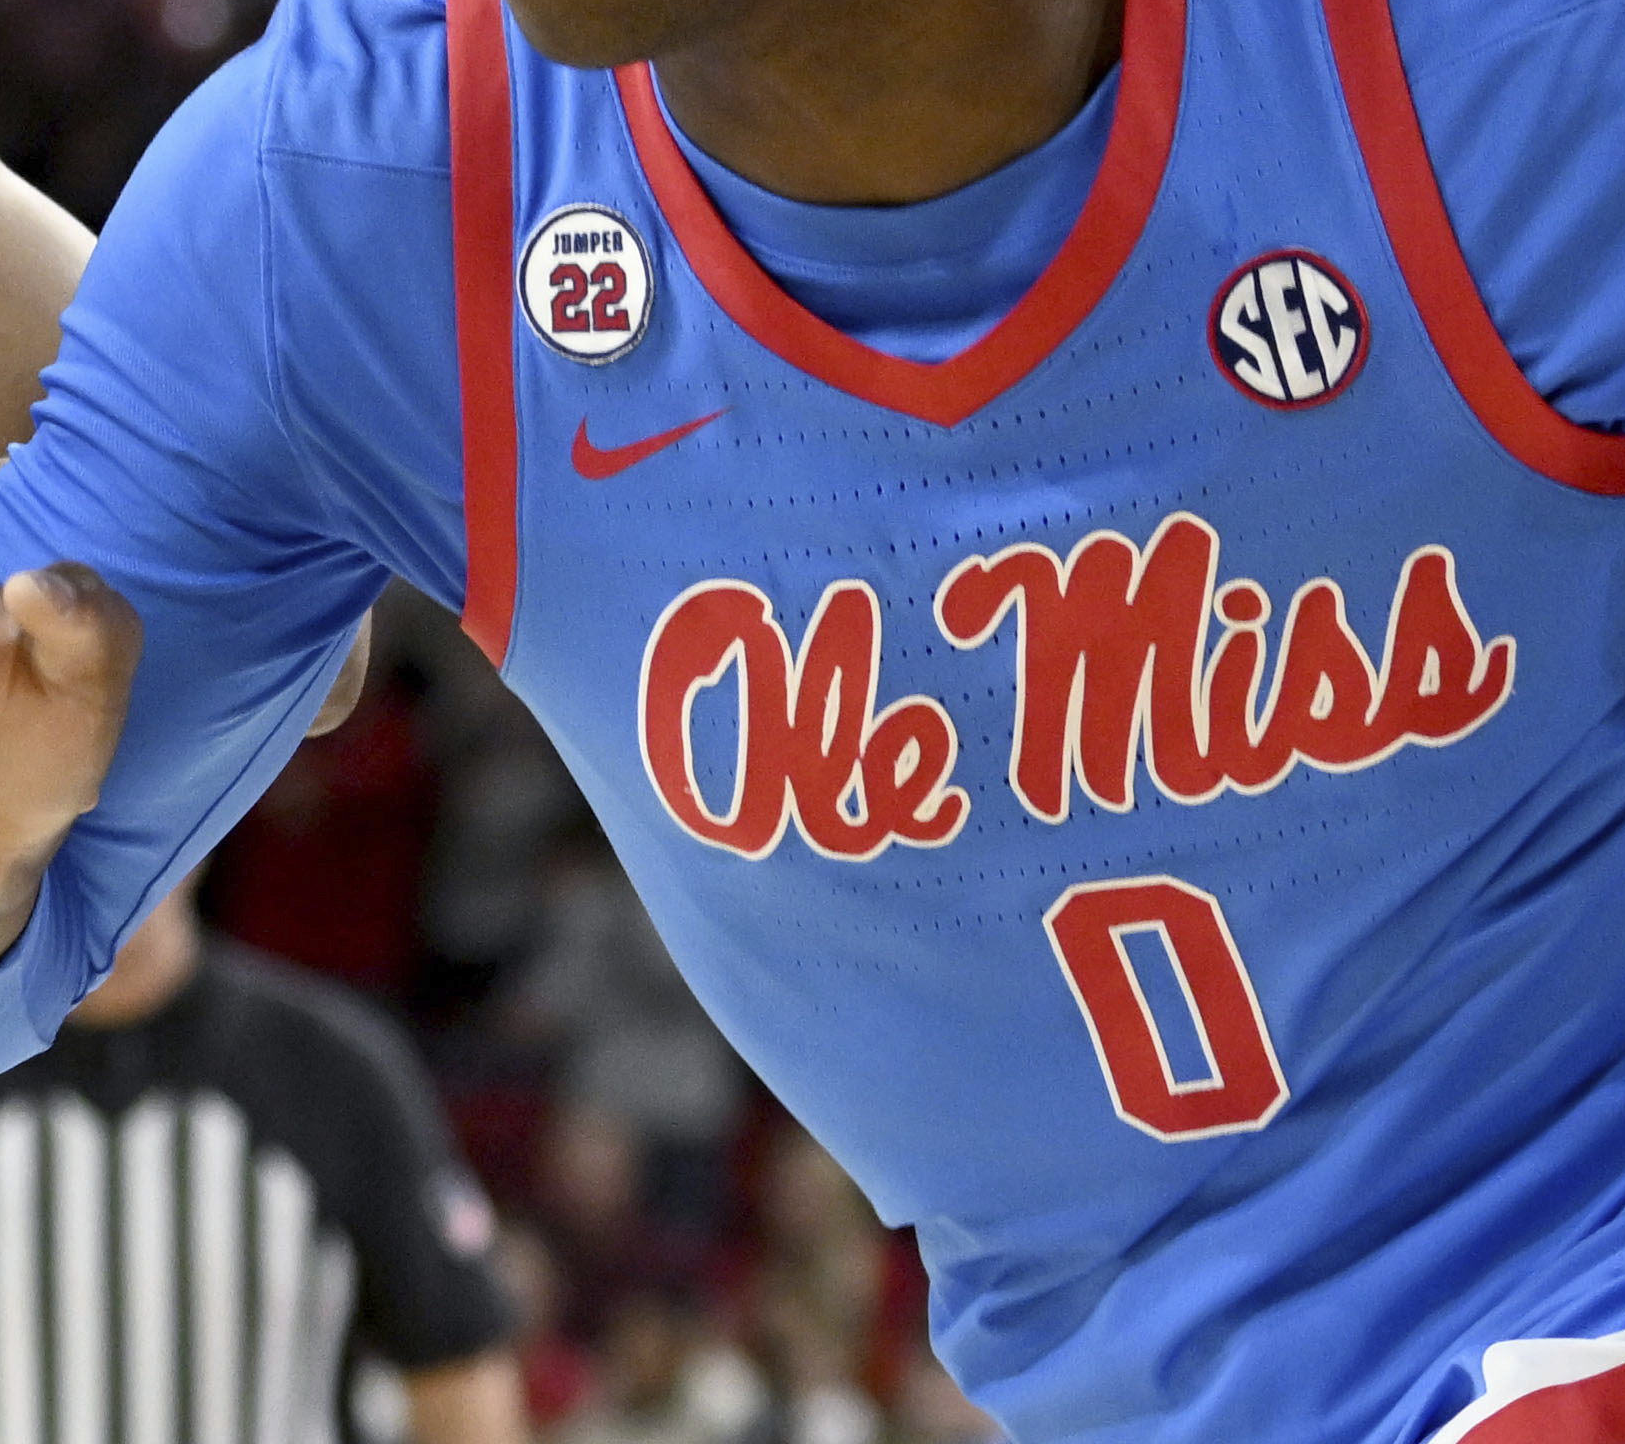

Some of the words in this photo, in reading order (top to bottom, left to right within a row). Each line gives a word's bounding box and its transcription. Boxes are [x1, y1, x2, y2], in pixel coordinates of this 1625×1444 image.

[548, 261, 632, 333] 22
[552, 229, 624, 256] JUMPER
[1219, 258, 1357, 401] SEC
[637, 577, 970, 862] Ole
[934, 510, 1517, 824] Miss
[1041, 874, 1292, 1144] 0
